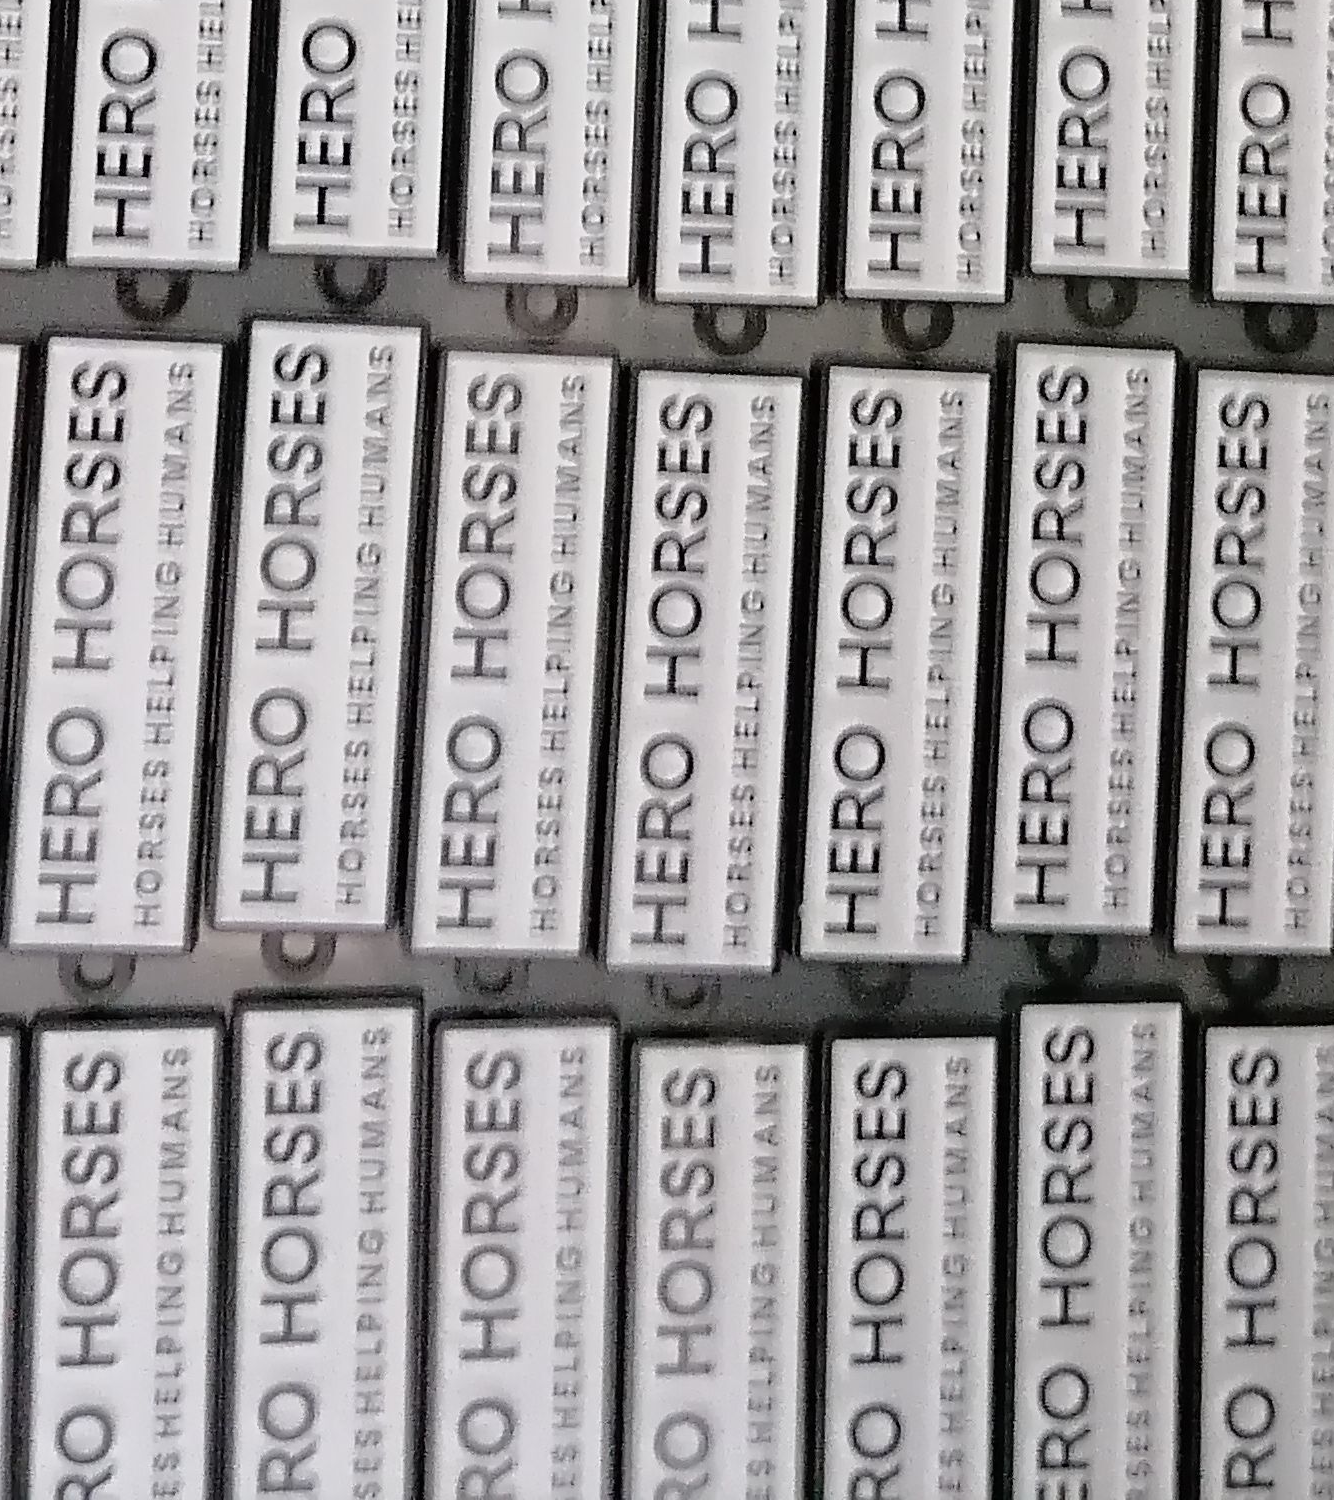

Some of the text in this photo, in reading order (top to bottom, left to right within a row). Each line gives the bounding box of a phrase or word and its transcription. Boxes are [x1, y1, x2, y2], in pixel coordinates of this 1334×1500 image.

[293, 18, 360, 229] HERO
[487, 50, 551, 258] HERO
[867, 71, 929, 275] HERO
[240, 344, 331, 902] HERO HORSES
[333, 345, 397, 905] HORSES HELPING HUMANS
[631, 394, 716, 944] HERO HORSES
[1014, 366, 1092, 906] HERO HORSES
[261, 1032, 324, 1347] HORSES
[352, 1027, 390, 1413] HELPING HUMANS
[852, 1061, 909, 1366] HORSES
[1039, 1026, 1097, 1330] HORSES
